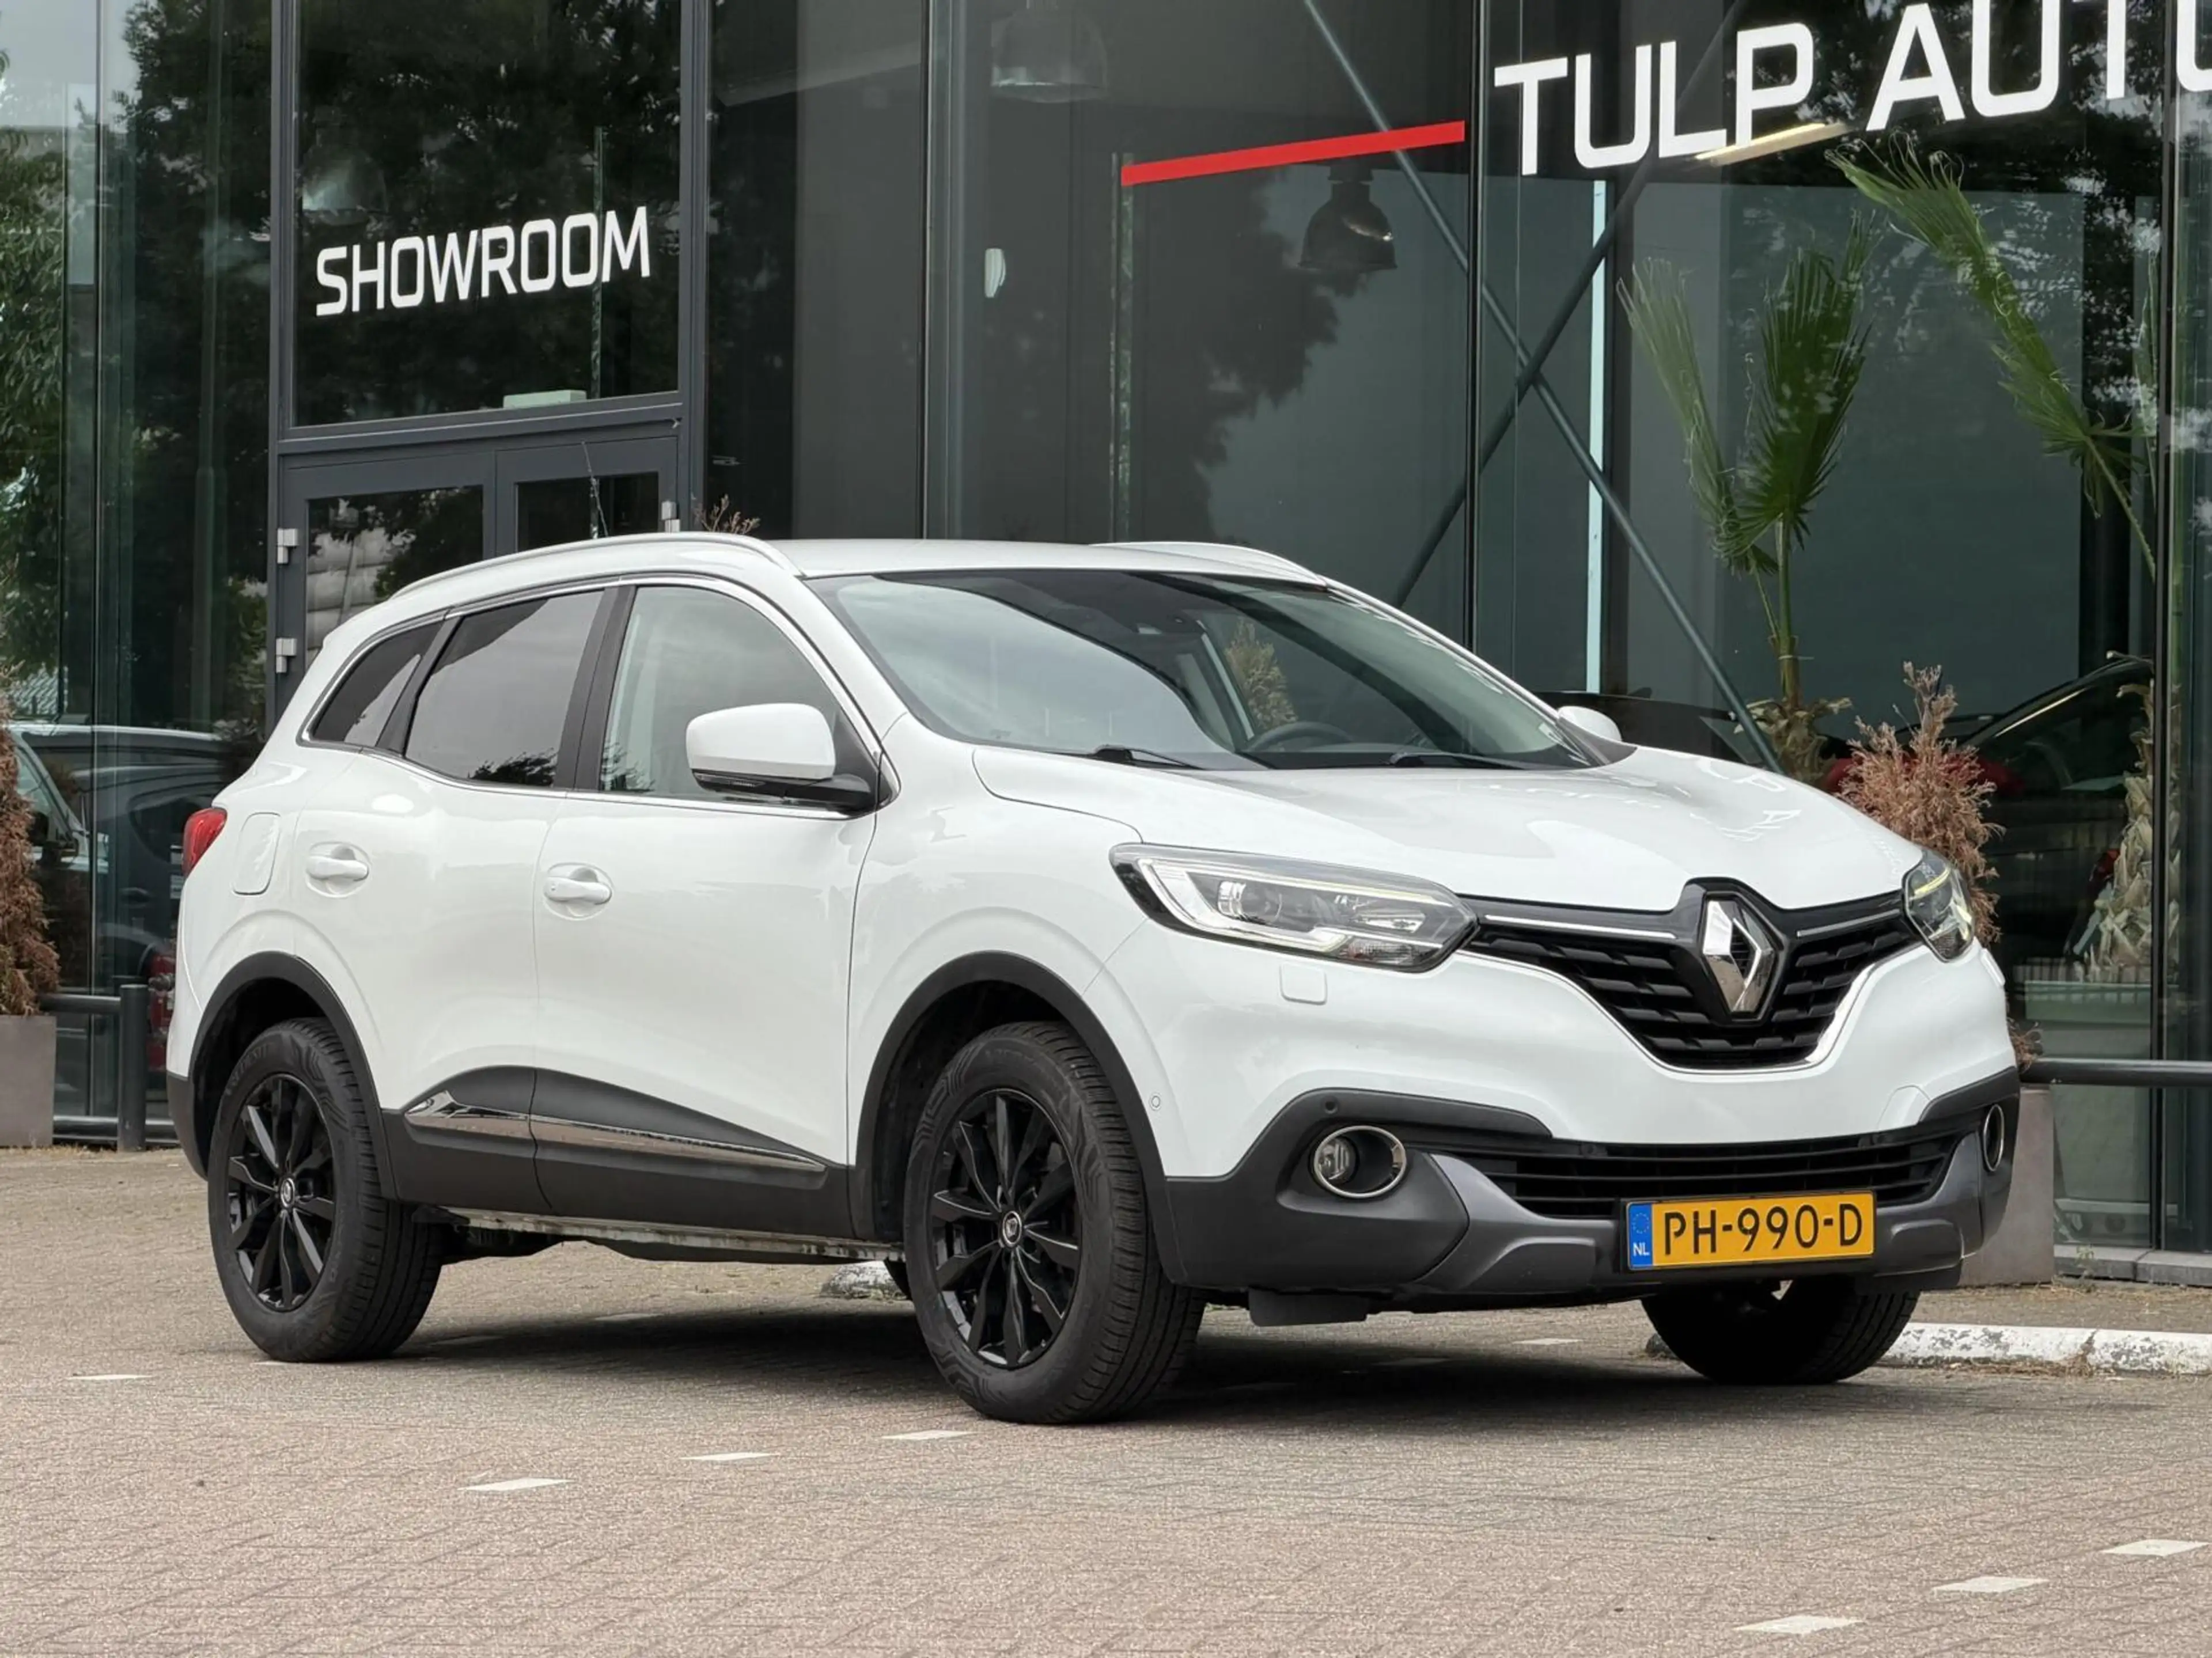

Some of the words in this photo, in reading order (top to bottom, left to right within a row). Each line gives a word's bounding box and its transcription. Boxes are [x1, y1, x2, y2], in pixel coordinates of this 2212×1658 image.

[1494, 22, 1813, 176] TULP
[316, 206, 651, 317] SHOWROOM
[1633, 1241, 1650, 1256] NL
[1664, 1202, 1862, 1256] PH-990-D
